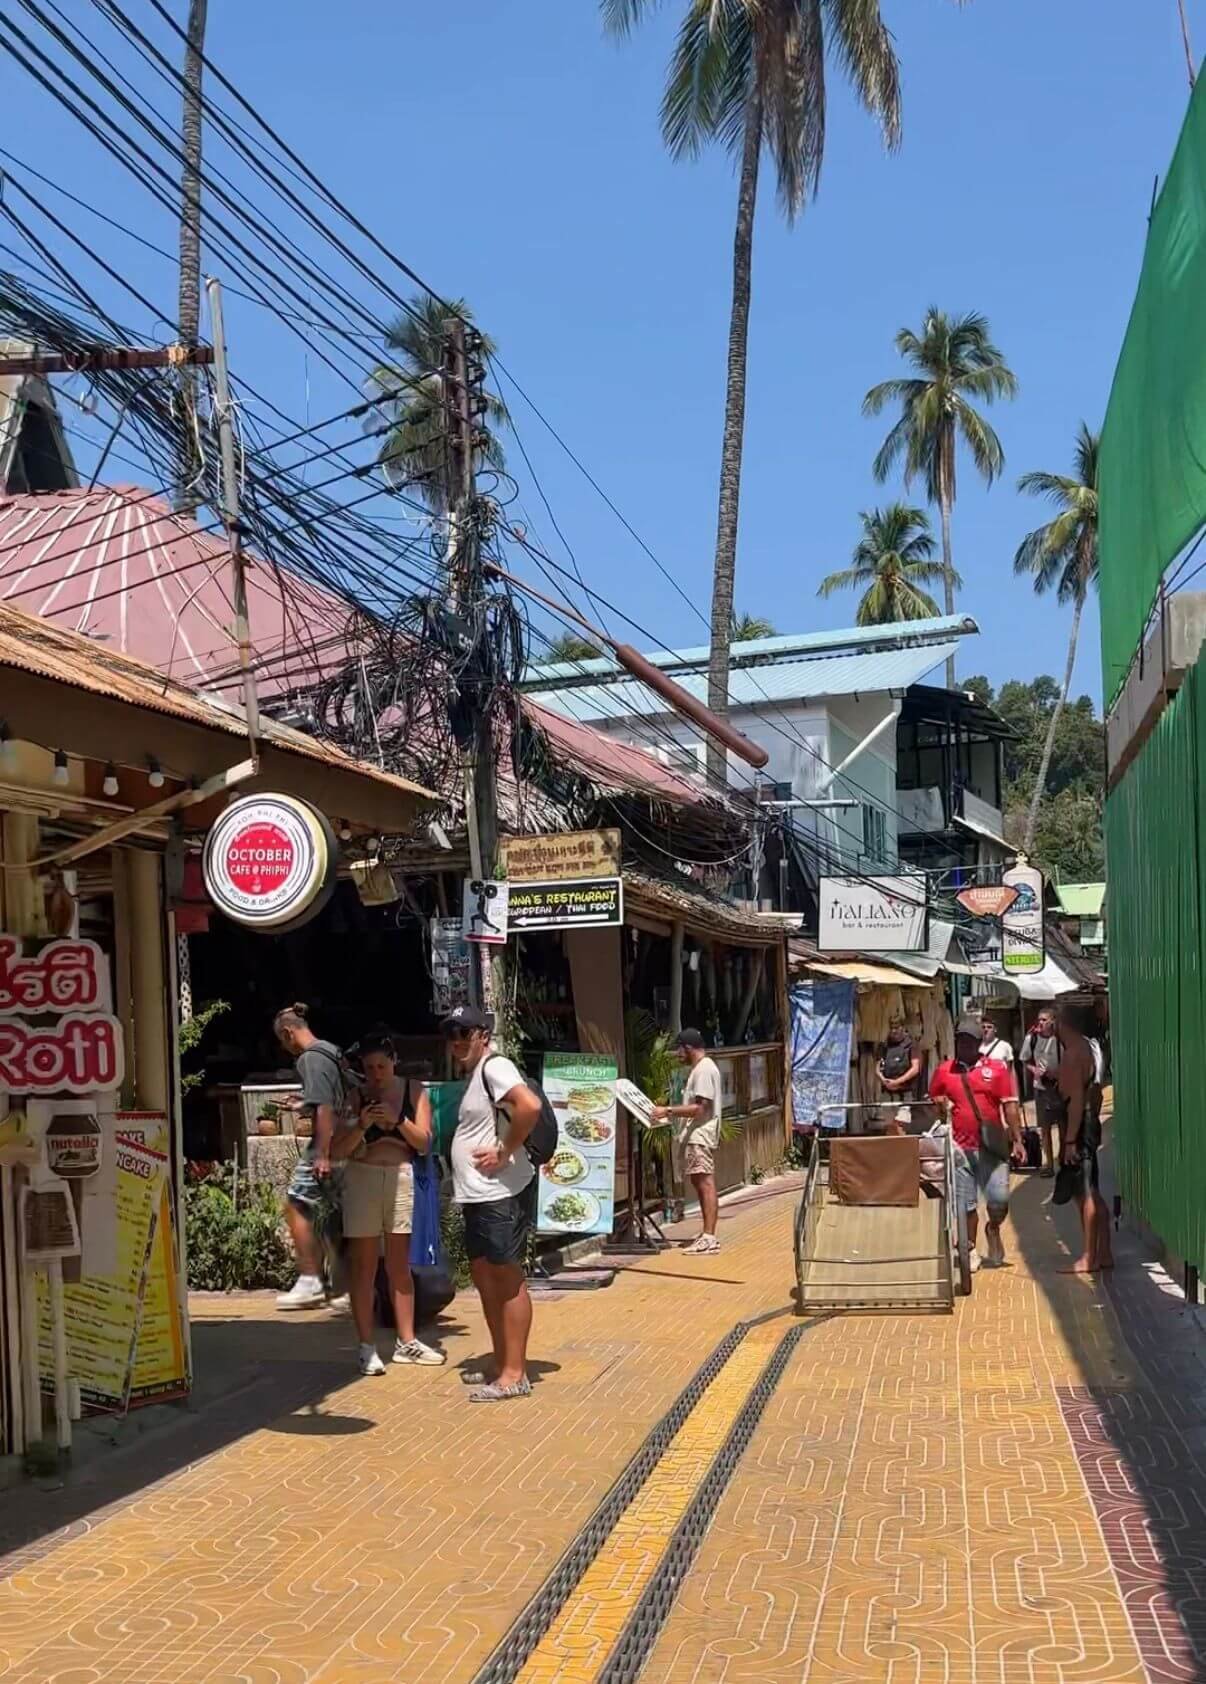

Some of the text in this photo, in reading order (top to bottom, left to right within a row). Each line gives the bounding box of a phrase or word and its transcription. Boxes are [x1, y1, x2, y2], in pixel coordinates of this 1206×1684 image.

[228, 848, 292, 862] OCTOBER
[230, 864, 250, 875] CAFE
[260, 865, 289, 875] PHIPHI
[546, 889, 617, 905] RESTAURANT
[566, 904, 587, 914] THAI
[590, 902, 616, 912] FOOD
[865, 921, 904, 929] restaurant
[0, 1027, 109, 1079] Roti
